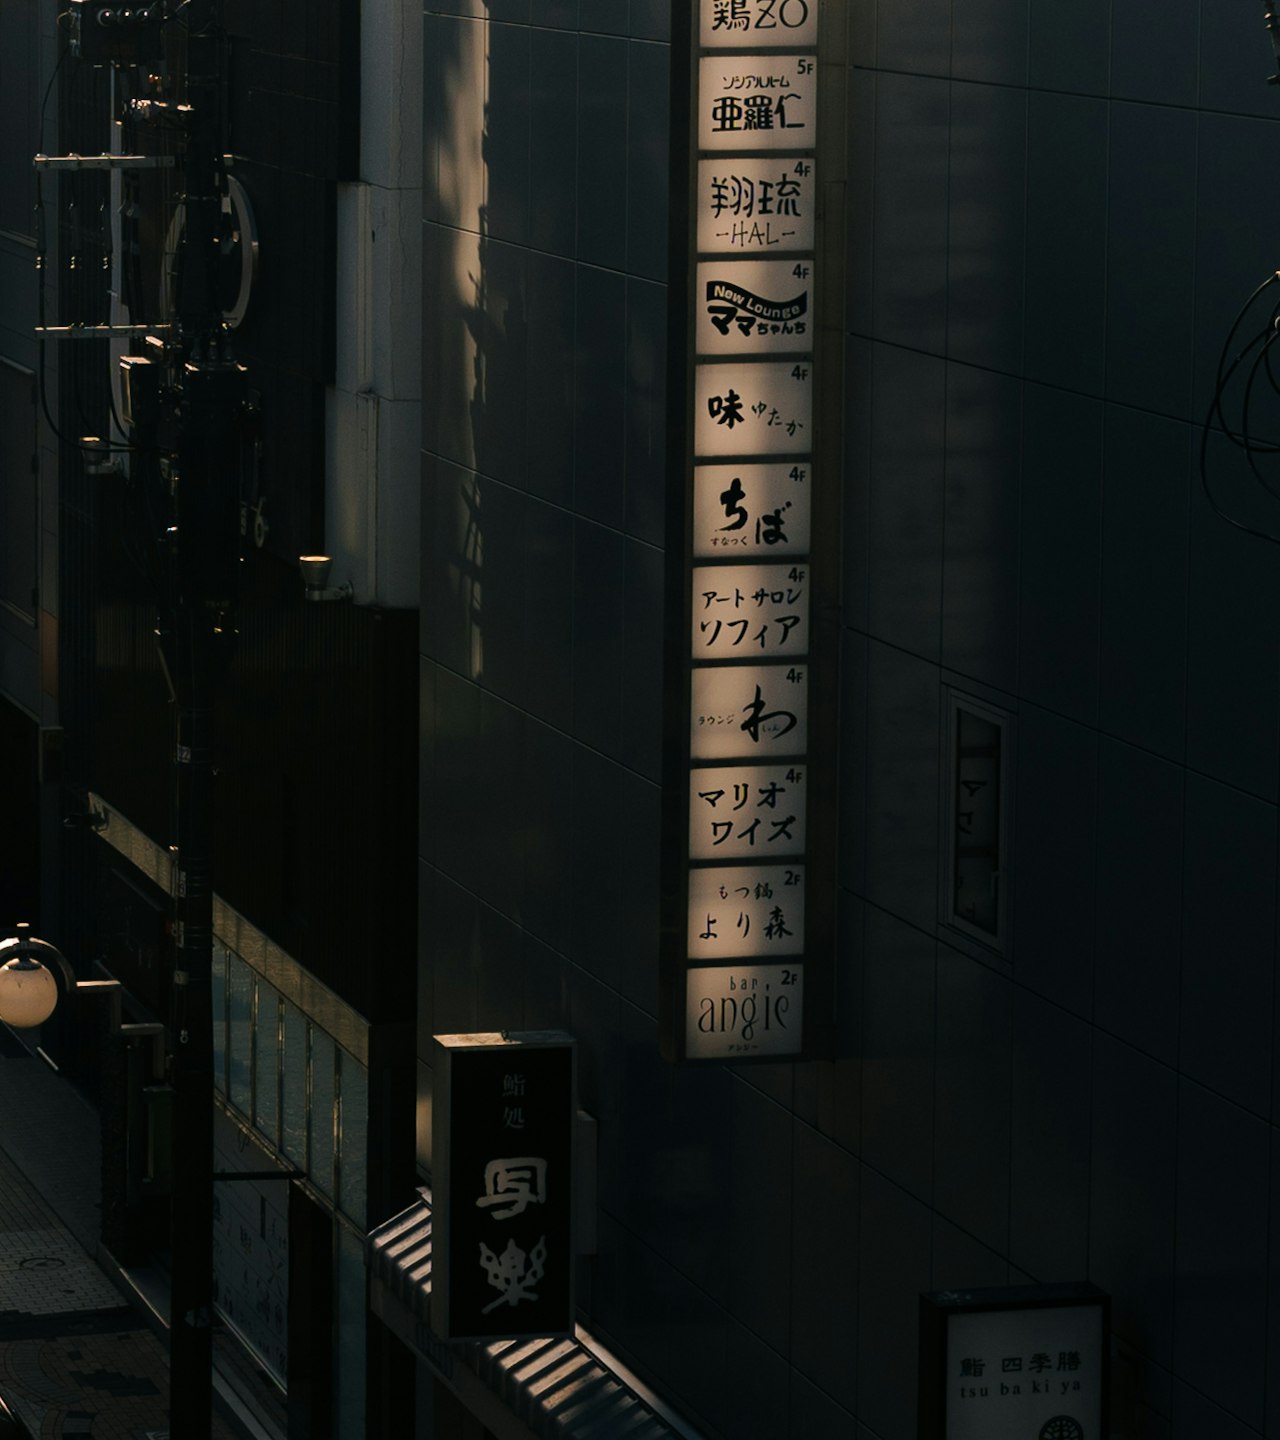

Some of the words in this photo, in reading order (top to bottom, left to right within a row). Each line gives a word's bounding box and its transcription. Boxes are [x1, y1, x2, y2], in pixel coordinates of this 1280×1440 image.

[796, 59, 814, 75] 5F
[794, 161, 811, 177] 4F
[710, 173, 802, 218] 翔琉
[792, 263, 809, 279] 4F
[714, 284, 745, 306] New
[745, 297, 801, 321] Lounge
[707, 305, 807, 337] ママちゃんち
[790, 364, 808, 381] 4F
[708, 389, 745, 429] 味
[751, 400, 804, 437] ゆたか
[788, 466, 806, 482] 4F
[715, 478, 793, 545] ちば
[788, 567, 805, 583] 4F
[701, 589, 745, 609] アート
[751, 588, 802, 605] サロン
[700, 615, 801, 648] ソフィア
[786, 668, 803, 683] 4F
[785, 768, 803, 784] 4F
[698, 782, 786, 810] マリオ
[711, 815, 796, 846] ワイズ
[784, 870, 801, 886] 2F
[719, 882, 773, 900] もつ鍋
[699, 905, 793, 940] より森
[729, 976, 759, 991] bar
[780, 969, 798, 986] 2F
[697, 984, 790, 1041] angie
[960, 1381, 989, 1399] tsu
[1001, 1381, 1022, 1396] ba
[1032, 1379, 1050, 1394] ki
